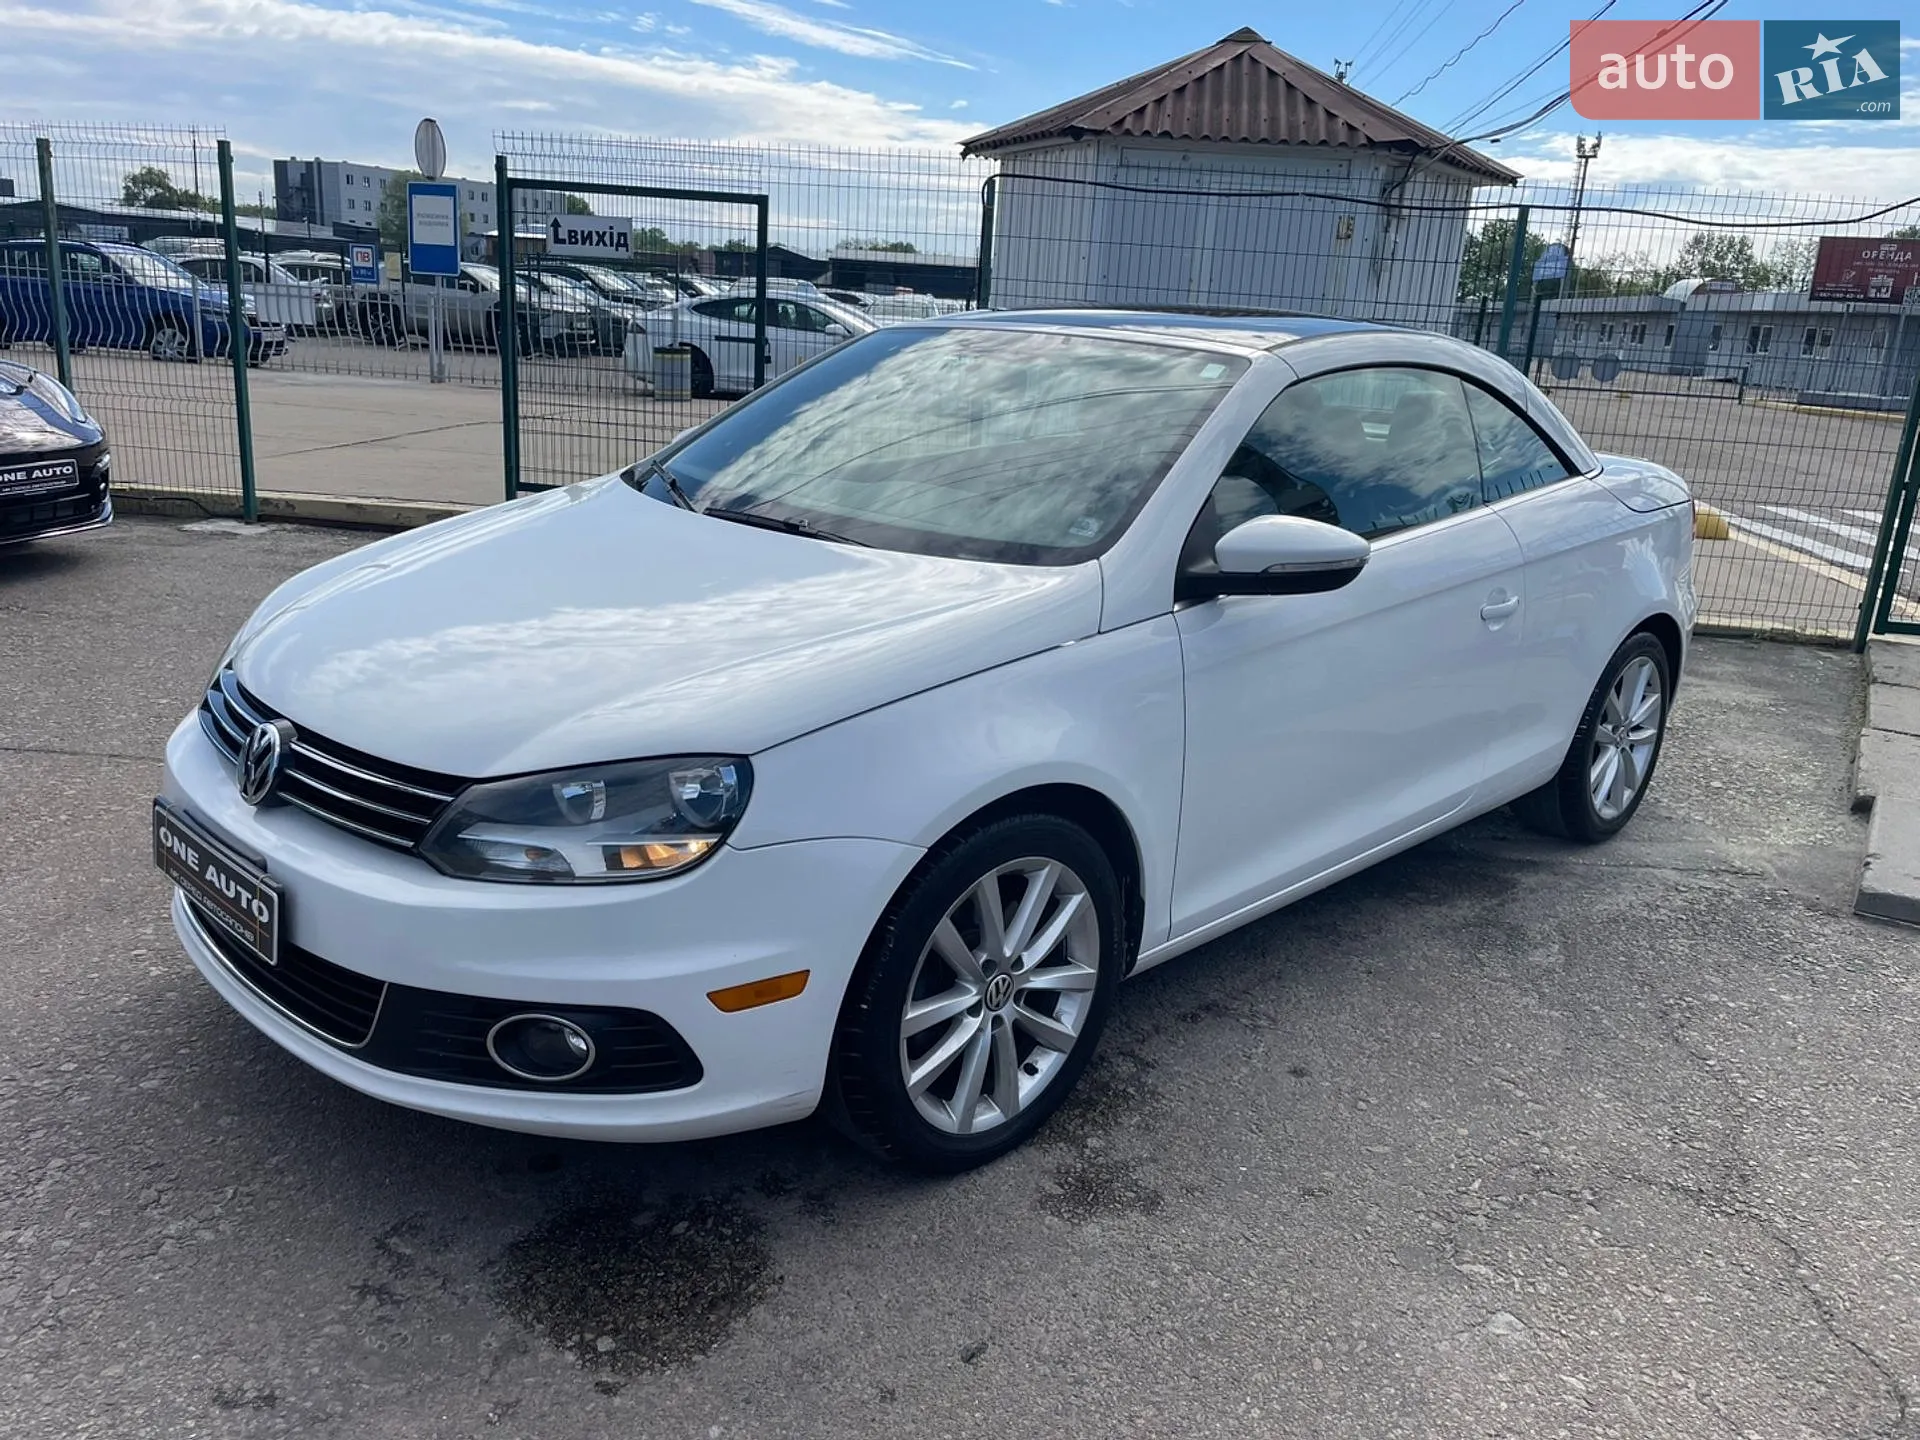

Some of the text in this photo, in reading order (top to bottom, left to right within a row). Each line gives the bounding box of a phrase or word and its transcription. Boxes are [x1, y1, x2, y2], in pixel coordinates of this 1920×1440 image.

[1862, 250, 1912, 262] ОРЕНДА
[0, 465, 73, 482] NE AUTO
[158, 826, 270, 923] ONE AUTO
